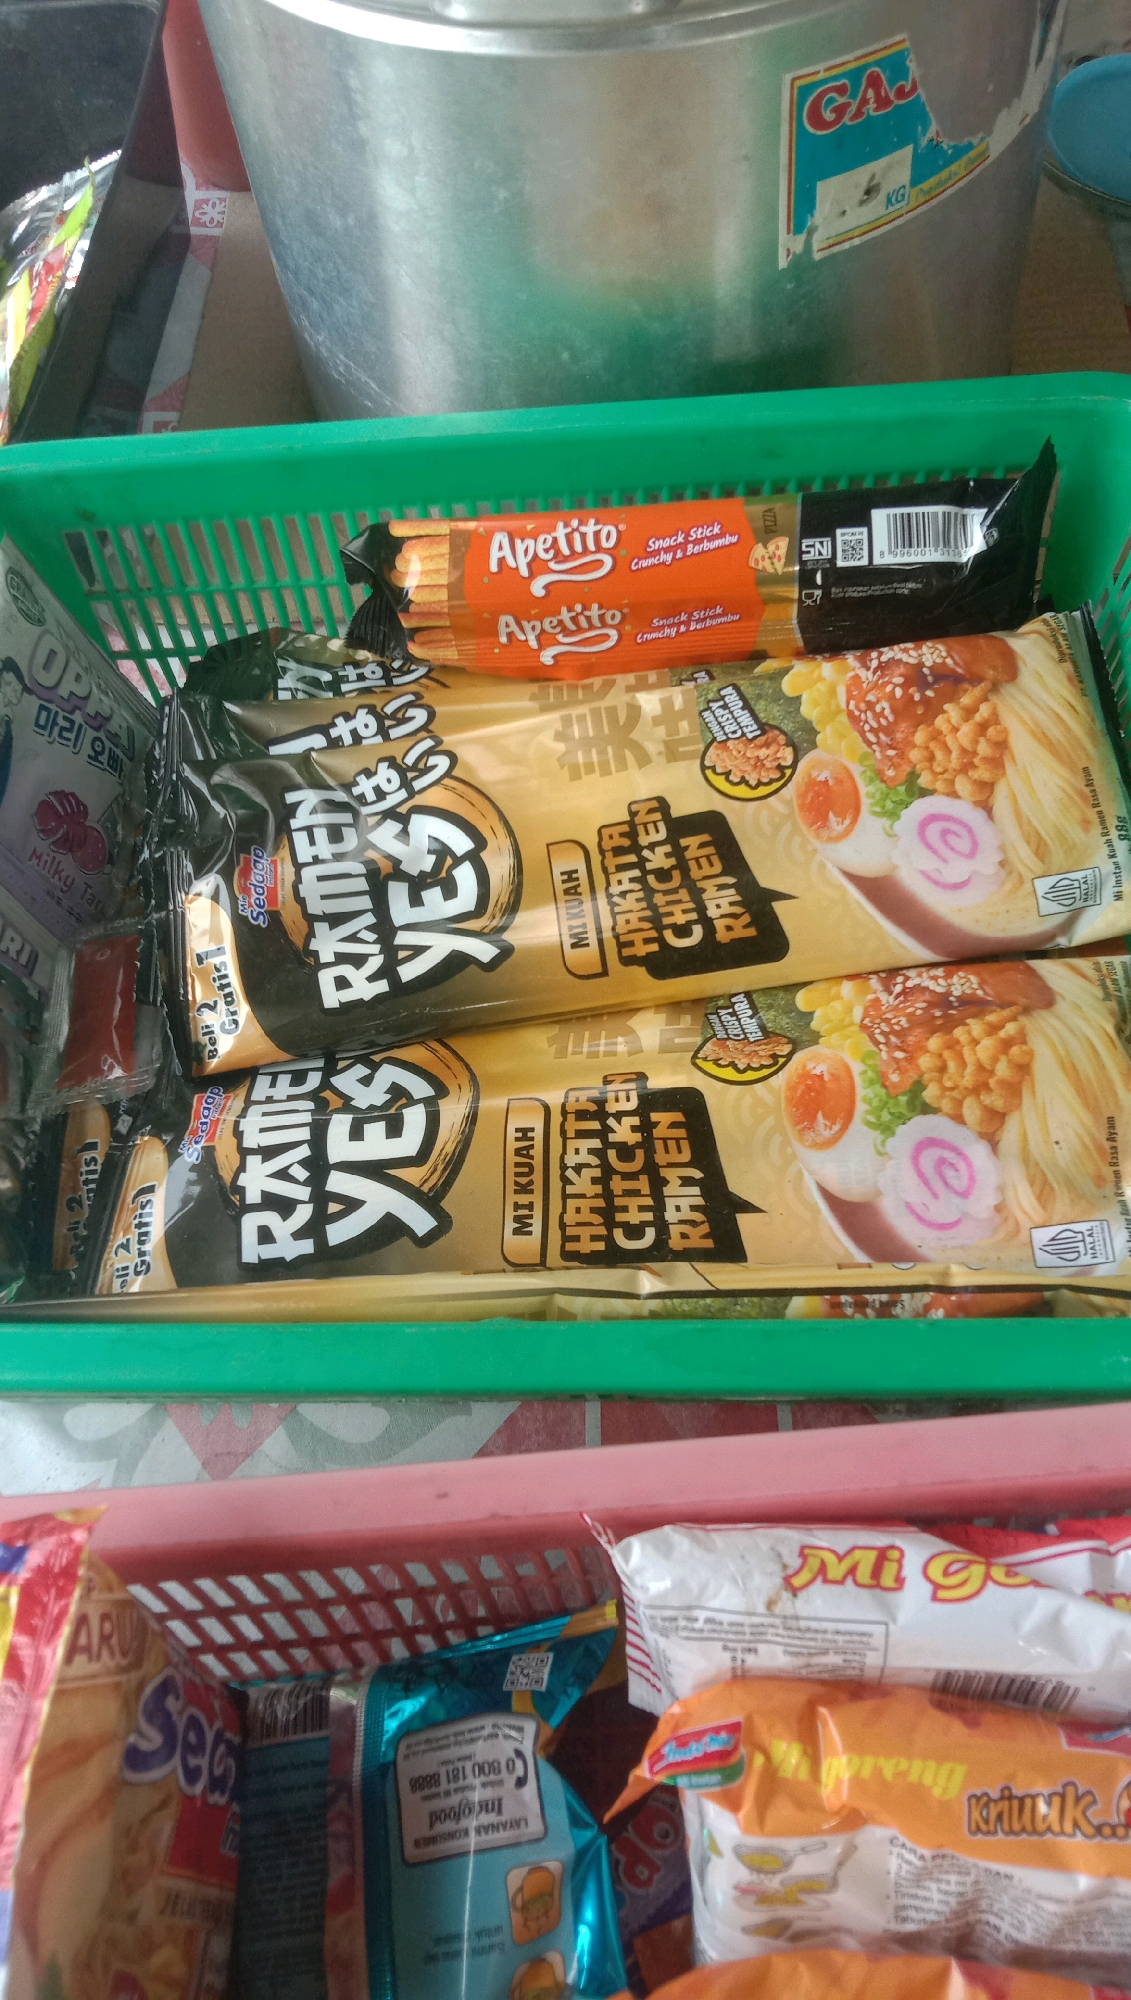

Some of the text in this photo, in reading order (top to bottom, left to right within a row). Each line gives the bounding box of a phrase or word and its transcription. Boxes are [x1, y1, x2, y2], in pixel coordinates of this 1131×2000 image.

[885, 184, 906, 211] KG
[489, 518, 617, 578] Apetito
[646, 521, 721, 551] Snack Stick
[764, 507, 777, 535] PIZZA
[802, 538, 831, 560] SNI
[631, 533, 739, 571] Crunchy & Berbumbu
[497, 603, 622, 650] Apetito
[636, 625, 677, 643] Crunchy
[688, 612, 740, 631] Berbumbu
[651, 605, 724, 627] Snack Stick
[709, 701, 742, 739] CRISPY
[720, 686, 761, 740] TEMPURA
[352, 737, 452, 815] はい
[1082, 766, 1124, 902] Mi Instan Kuah Ramen Rasa Ayam
[28, 848, 76, 895] Milky
[248, 846, 271, 927] Sedaap
[285, 788, 389, 1009] RAMEN
[366, 812, 501, 983] YES
[601, 824, 660, 958] HAKATA
[632, 800, 704, 948] CHICKEN
[680, 833, 757, 944] RAMEN
[1081, 874, 1089, 902] HALAL
[560, 868, 590, 950] MI KUAH
[195, 946, 239, 1034] Gratis 1
[731, 993, 764, 1042] TEMPURA
[196, 1000, 218, 1060] Beli 2
[717, 1008, 745, 1040] CRISPY
[186, 1087, 223, 1162] Sedaap
[1106, 1116, 1118, 1142] Ayam
[237, 1058, 326, 1264] RAME
[326, 1063, 438, 1248] YES
[512, 1127, 535, 1236] MI KUAH
[564, 1089, 607, 1253] HAKATA
[605, 1073, 656, 1250] CHICKEN
[650, 1112, 715, 1250] RAMEN
[1108, 1146, 1120, 1167] Rasa
[66, 1193, 83, 1213] 2
[132, 1182, 157, 1277] Gratis 1
[115, 1236, 132, 1294] eli 2
[1086, 1226, 1098, 1259] HALAL
[788, 1545, 905, 1591] Mi
[445, 1765, 467, 1786] 181
[474, 1817, 528, 1837] LAYANAN
